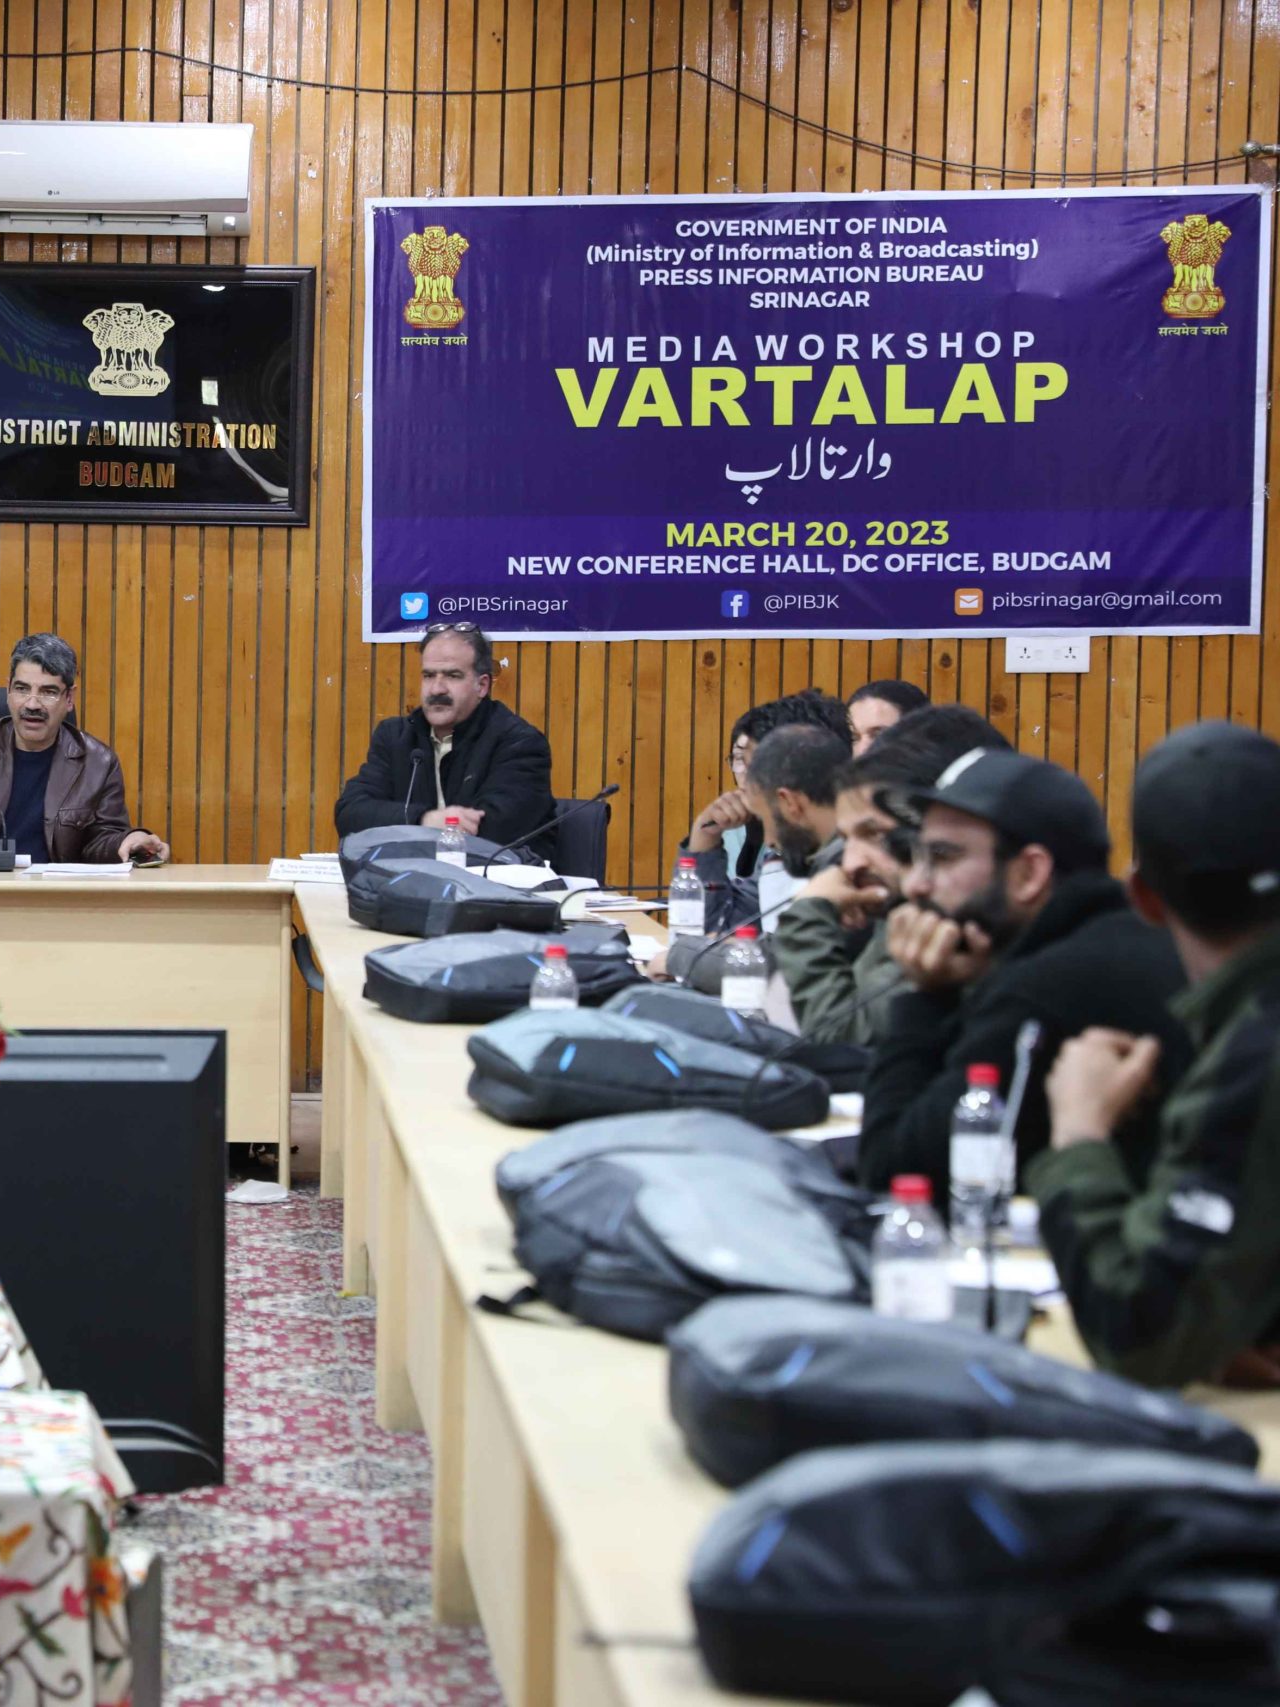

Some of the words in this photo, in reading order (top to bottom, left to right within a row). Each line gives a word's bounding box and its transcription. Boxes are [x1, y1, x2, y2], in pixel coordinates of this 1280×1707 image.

[675, 218, 838, 237] GOVERNMENT
[844, 218, 876, 236] OF
[882, 217, 948, 235] INDIA
[587, 244, 685, 265] (Ministry
[690, 244, 714, 261] of
[719, 241, 852, 260] Information
[859, 242, 873, 258] &
[879, 240, 1039, 262] Broadcasting)
[639, 269, 713, 286] PRESS
[719, 266, 880, 285] INFORMATION
[887, 265, 984, 284] BUREAU
[750, 291, 869, 308] SRINAGAR
[400, 333, 440, 346] सत्यमेव
[442, 332, 468, 346] जयते
[1157, 323, 1198, 336] सत्यमेव
[1200, 322, 1229, 336] जयते
[589, 336, 737, 362] MEDIA
[755, 332, 1034, 360] WORKSHOP
[555, 362, 1068, 427] VARTALAP
[87, 420, 276, 449] ADMINISTRATION
[80, 461, 175, 488] BUDGAM
[726, 437, 891, 504] وارتالاپ
[667, 522, 795, 547] MARCH
[806, 522, 858, 550] 20,
[866, 521, 949, 545] 2023
[508, 556, 570, 576] NEW
[576, 555, 756, 575] CONFERENCE
[764, 554, 836, 577] HALL,
[843, 554, 878, 572] DC
[884, 553, 986, 576] OFFICE,
[993, 552, 1110, 571] BUDGAM
[438, 595, 569, 616] @PIBSrinagar
[763, 594, 840, 613] @PIBJK
[992, 591, 1222, 612] pibsrinagar@gmail.com
